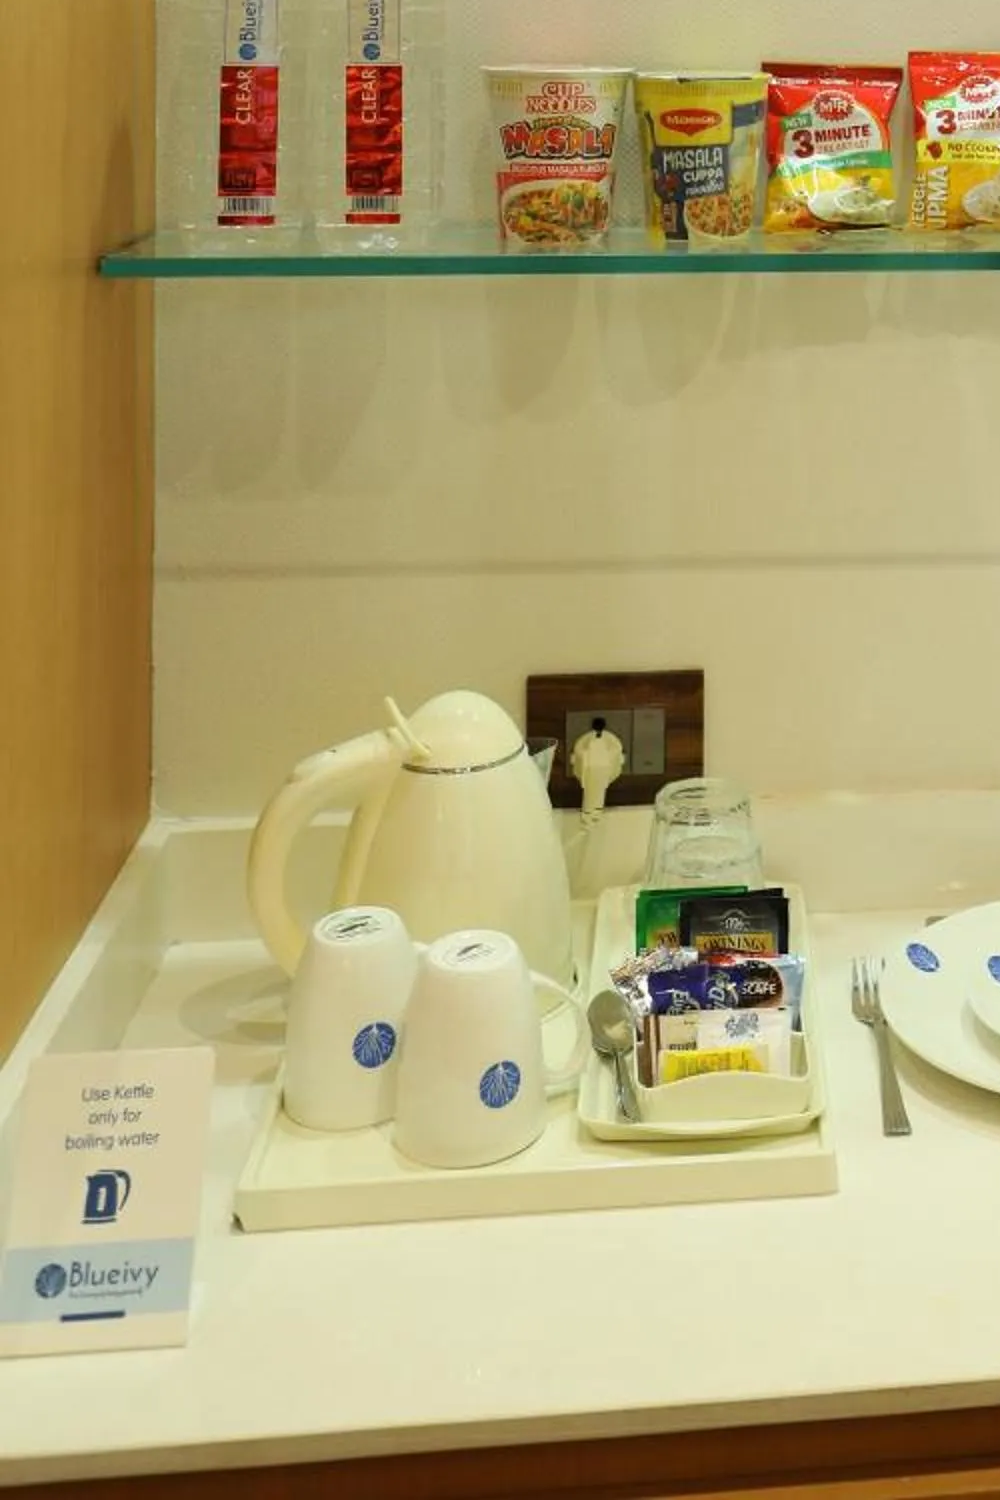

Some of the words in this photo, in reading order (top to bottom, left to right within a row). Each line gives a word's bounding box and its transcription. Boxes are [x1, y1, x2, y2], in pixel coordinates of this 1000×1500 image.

[235, 69, 253, 125] CLEAR
[361, 68, 378, 123] CLEAR
[543, 82, 584, 97] CUP
[820, 97, 848, 113] MTR
[935, 109, 957, 135] 3
[792, 129, 814, 158] 3
[814, 124, 870, 142] MINUTE
[663, 147, 723, 173] MASALA
[683, 168, 725, 183] CUPPA
[81, 1088, 111, 1102] Use
[115, 1083, 154, 1099] Kettle
[88, 1108, 119, 1126] only
[123, 1108, 142, 1122] for
[65, 1135, 115, 1151] boiling
[118, 1132, 160, 1147] water
[70, 1261, 159, 1289] Blueivy
